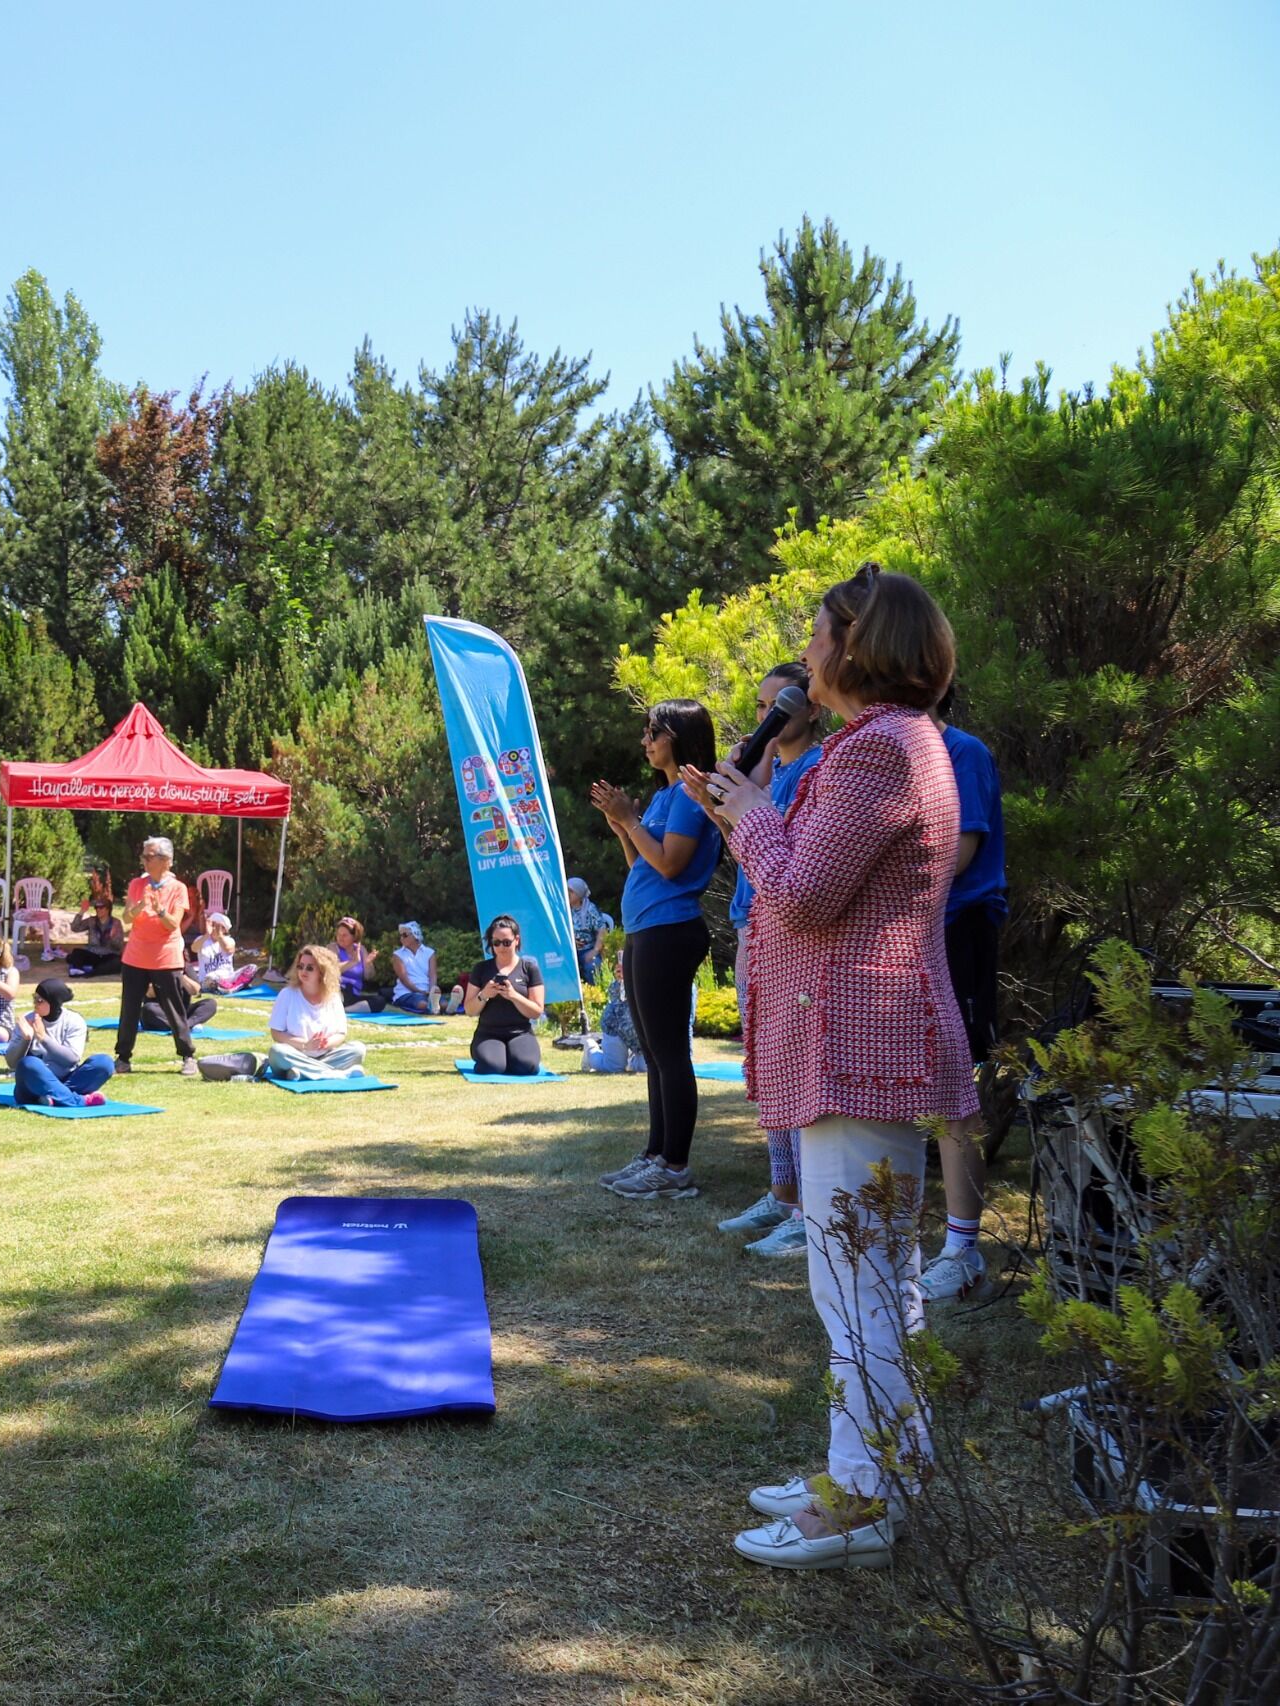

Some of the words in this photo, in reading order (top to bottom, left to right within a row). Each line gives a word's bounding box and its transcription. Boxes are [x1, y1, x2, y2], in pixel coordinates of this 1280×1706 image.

[28, 775, 108, 802] Hayallerin
[109, 782, 158, 806] gerçeğe
[159, 781, 232, 808] dönüştüğü
[234, 786, 269, 808] şehir
